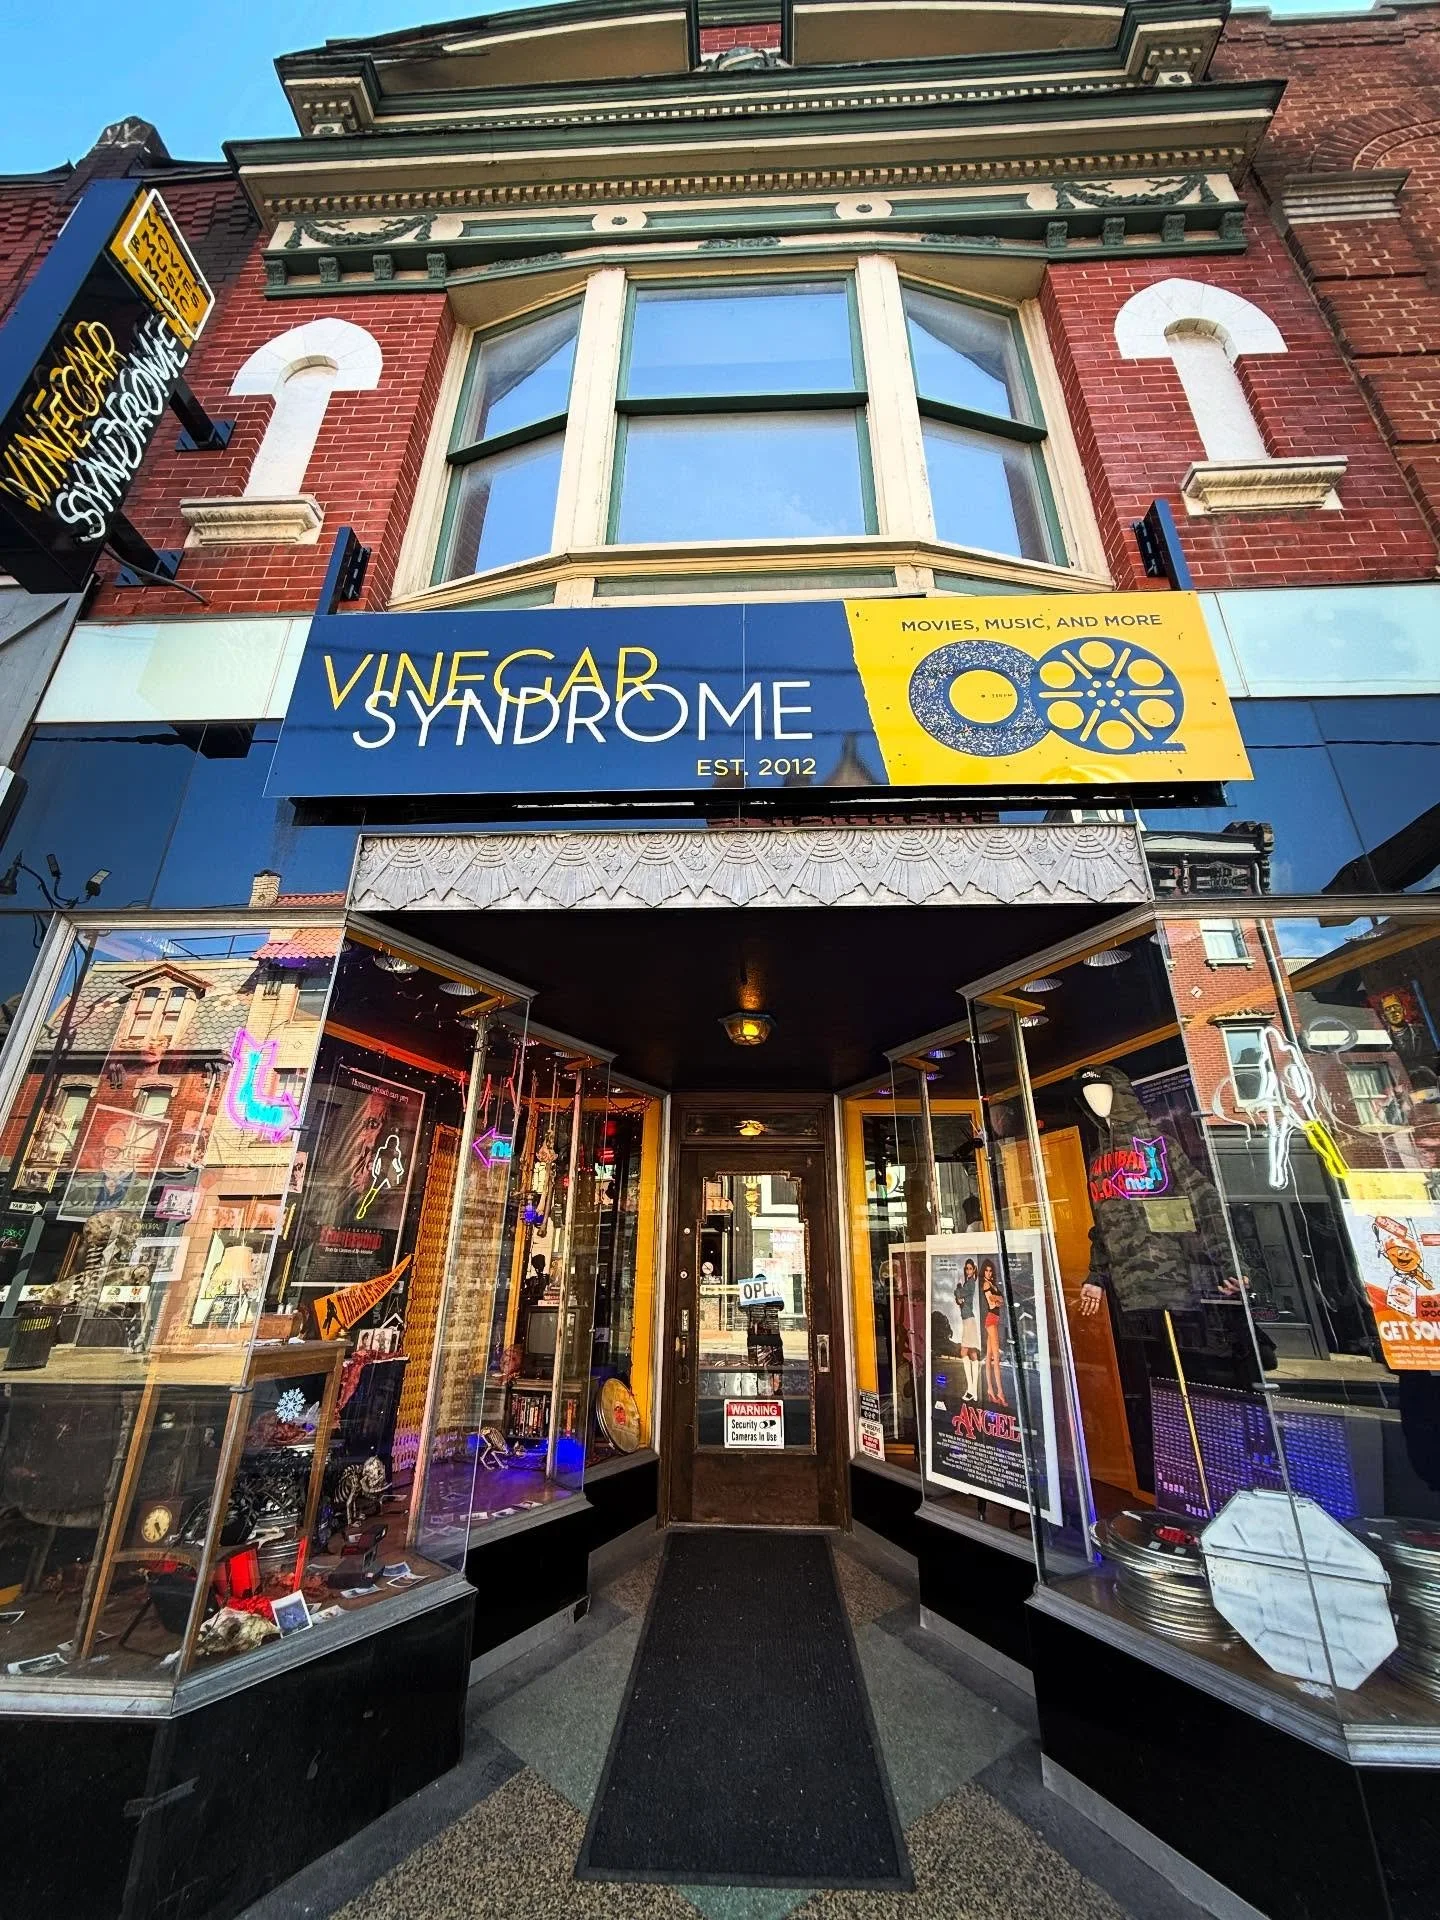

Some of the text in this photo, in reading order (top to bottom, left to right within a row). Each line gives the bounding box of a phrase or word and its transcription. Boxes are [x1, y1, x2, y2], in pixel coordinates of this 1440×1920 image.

[144, 209, 199, 308] MOVIES
[142, 230, 190, 313] MUSIC
[901, 614, 1162, 633] MOVIES, MUSIC, AND MORE
[324, 646, 658, 710] VINEGAR
[352, 681, 814, 748] SYNDROME
[697, 757, 817, 776] EST. 2012
[1380, 1320, 1410, 1341] GET
[730, 1404, 778, 1416] WARNING
[731, 1418, 758, 1431] Security
[951, 1403, 1022, 1442] ANGEL
[731, 1430, 758, 1442] Cameras
[766, 1431, 778, 1442] Use
